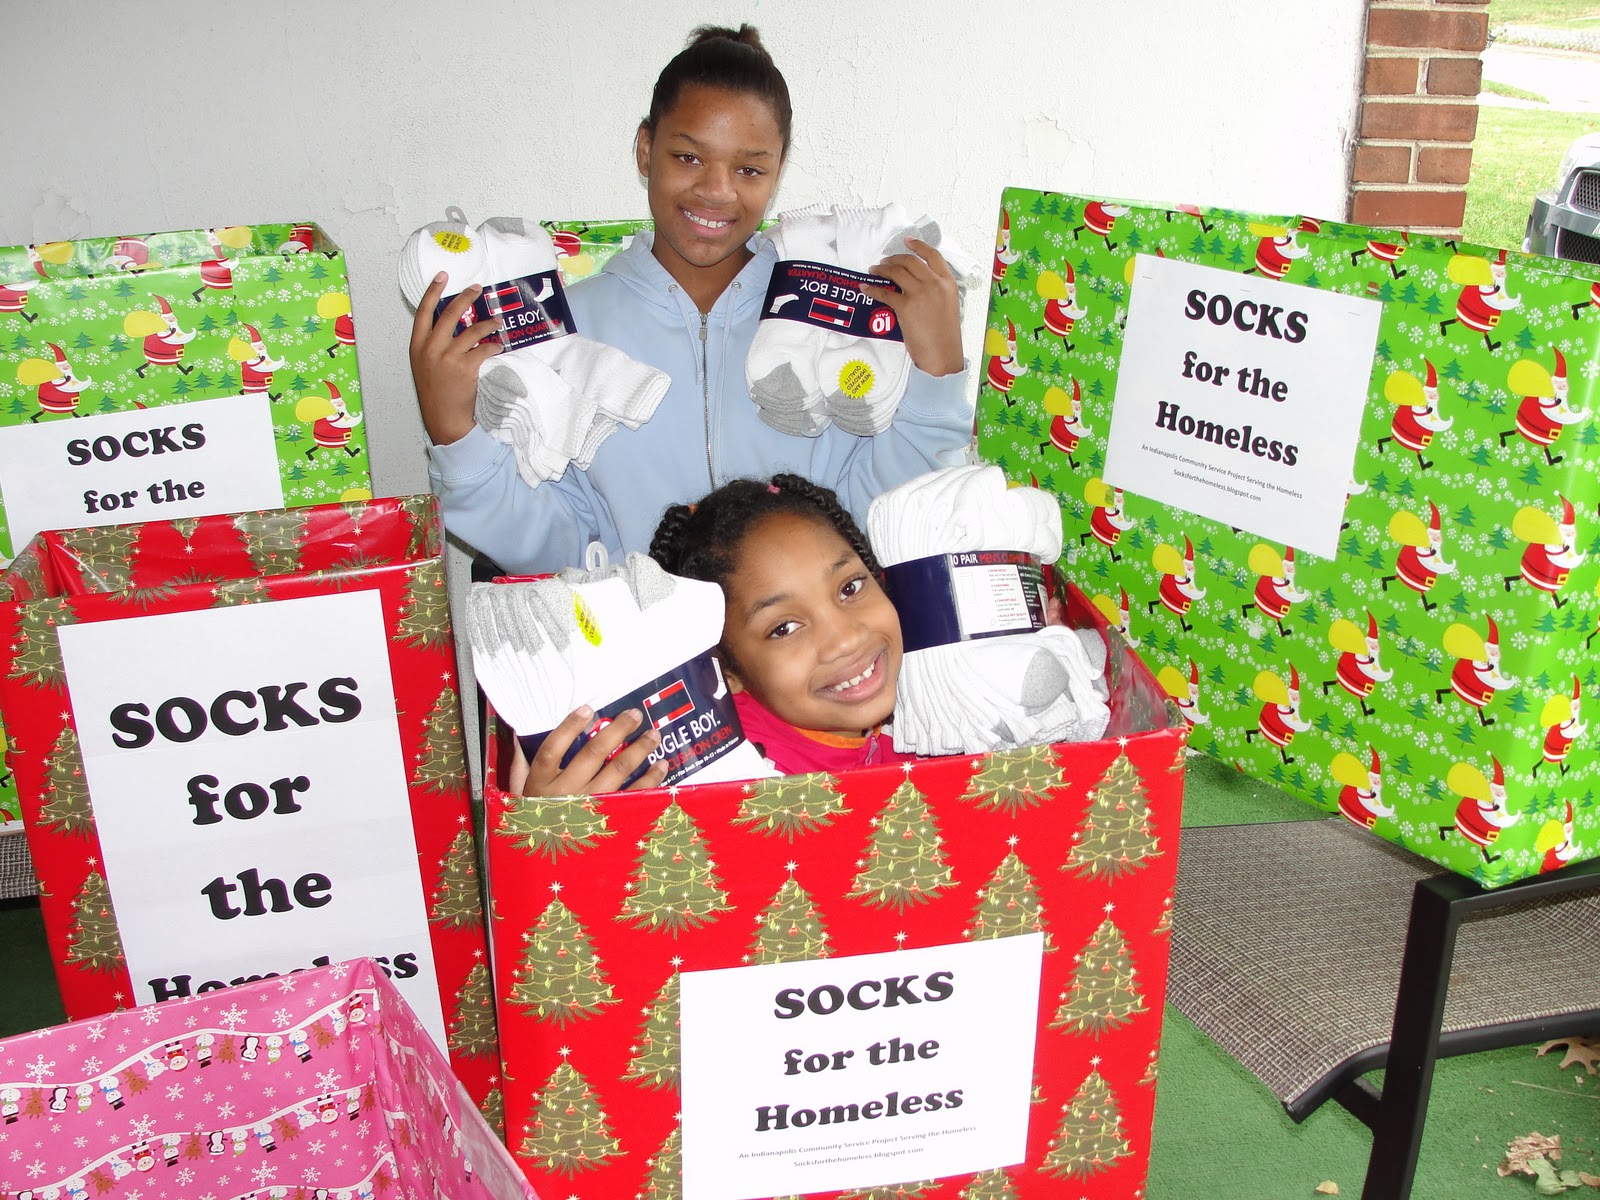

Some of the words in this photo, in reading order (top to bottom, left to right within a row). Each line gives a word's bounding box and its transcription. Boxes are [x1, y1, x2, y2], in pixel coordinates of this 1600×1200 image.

[800, 279, 829, 295] BOY
[517, 309, 540, 326] BOY
[872, 316, 890, 333] 10
[1185, 289, 1309, 344] SOCKS
[1182, 350, 1230, 387] for
[1238, 368, 1288, 403] the
[67, 424, 206, 466] SOCKS
[1156, 400, 1299, 467] Homeless
[1149, 446, 1178, 460] Indianapolis
[1179, 455, 1207, 470] Community
[1208, 464, 1226, 475] Service
[1227, 470, 1246, 481] Project
[1246, 475, 1266, 488] Serving
[1266, 482, 1275, 490] the
[1276, 485, 1303, 499] Homeless
[1174, 469, 1262, 502] Socksforthehomeless.blogspot.com
[84, 490, 139, 514] for
[147, 480, 205, 505] the
[960, 553, 979, 565] PAIR
[109, 676, 362, 749] SOCKS
[690, 709, 718, 738] BOY
[668, 738, 711, 771] CUSHION
[711, 724, 733, 745] CREW
[187, 774, 311, 826] for
[200, 867, 332, 921] the
[774, 971, 954, 1020] SOCKS
[784, 1048, 855, 1076] for
[867, 1037, 940, 1066] the
[755, 1089, 963, 1132] Homeless
[751, 1148, 797, 1157] Indianapolis
[798, 1144, 842, 1153] Community
[844, 1140, 870, 1148] Service
[872, 1136, 898, 1145] Project
[900, 1132, 926, 1141] Serving
[928, 1130, 940, 1138] the
[942, 1125, 977, 1135] Homeless
[794, 1147, 924, 1168] Socksforthehomeless.blogspot.com
